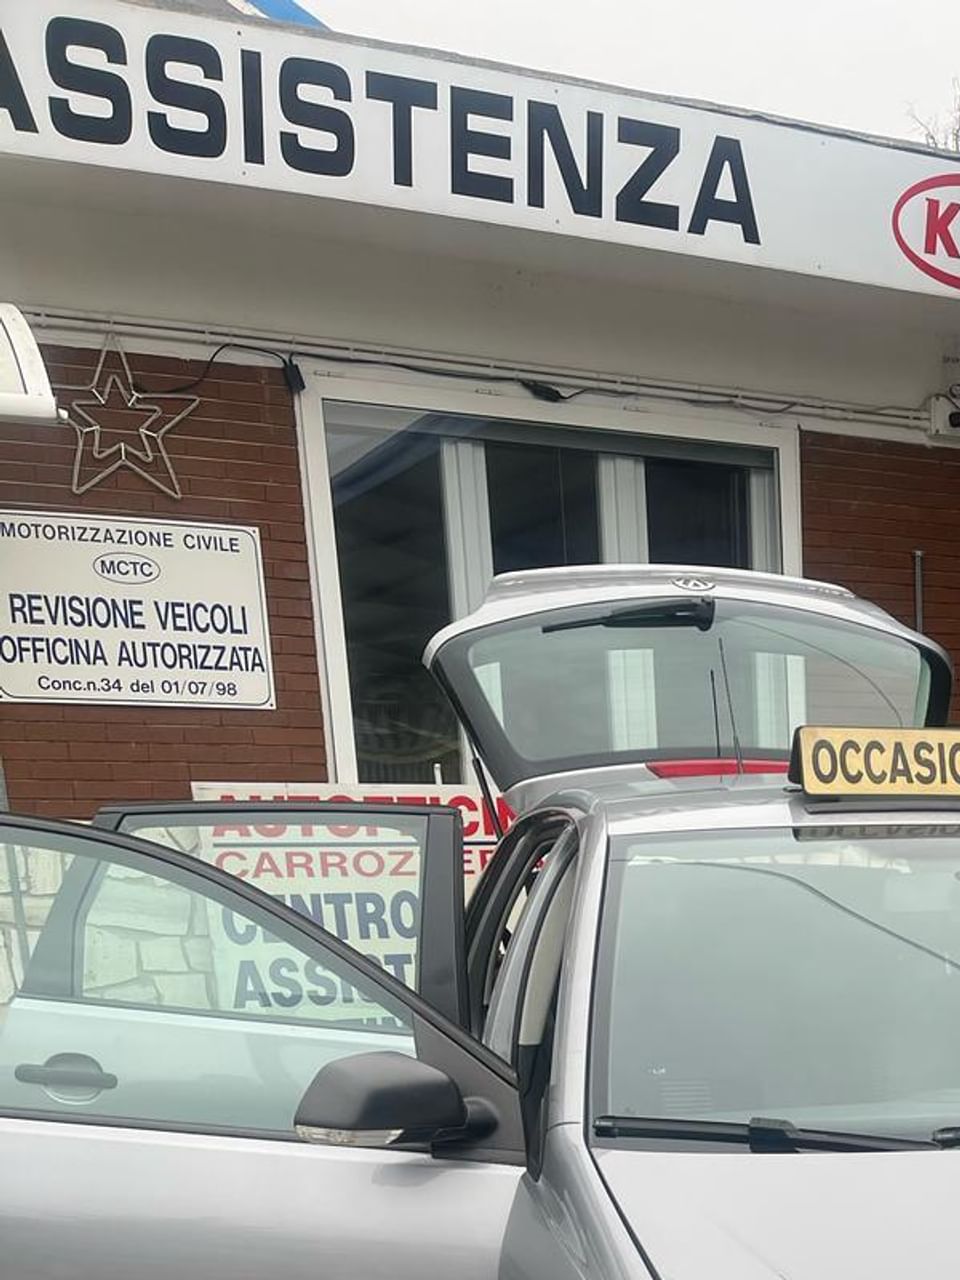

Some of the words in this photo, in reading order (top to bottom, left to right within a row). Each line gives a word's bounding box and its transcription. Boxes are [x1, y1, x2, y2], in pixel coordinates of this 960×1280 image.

[0, 522, 174, 548] MOTORIZZAZIONE
[183, 534, 240, 552] CIVILE
[100, 560, 154, 577] MCTC
[9, 593, 146, 629] REVISIONE
[154, 600, 248, 635] VEICOLI
[0, 635, 109, 667] OFFICINA
[117, 641, 266, 673] AUTORIZZATA
[38, 676, 123, 692] Conc.n.34
[130, 679, 154, 694] del
[161, 679, 238, 696] 01/07/98
